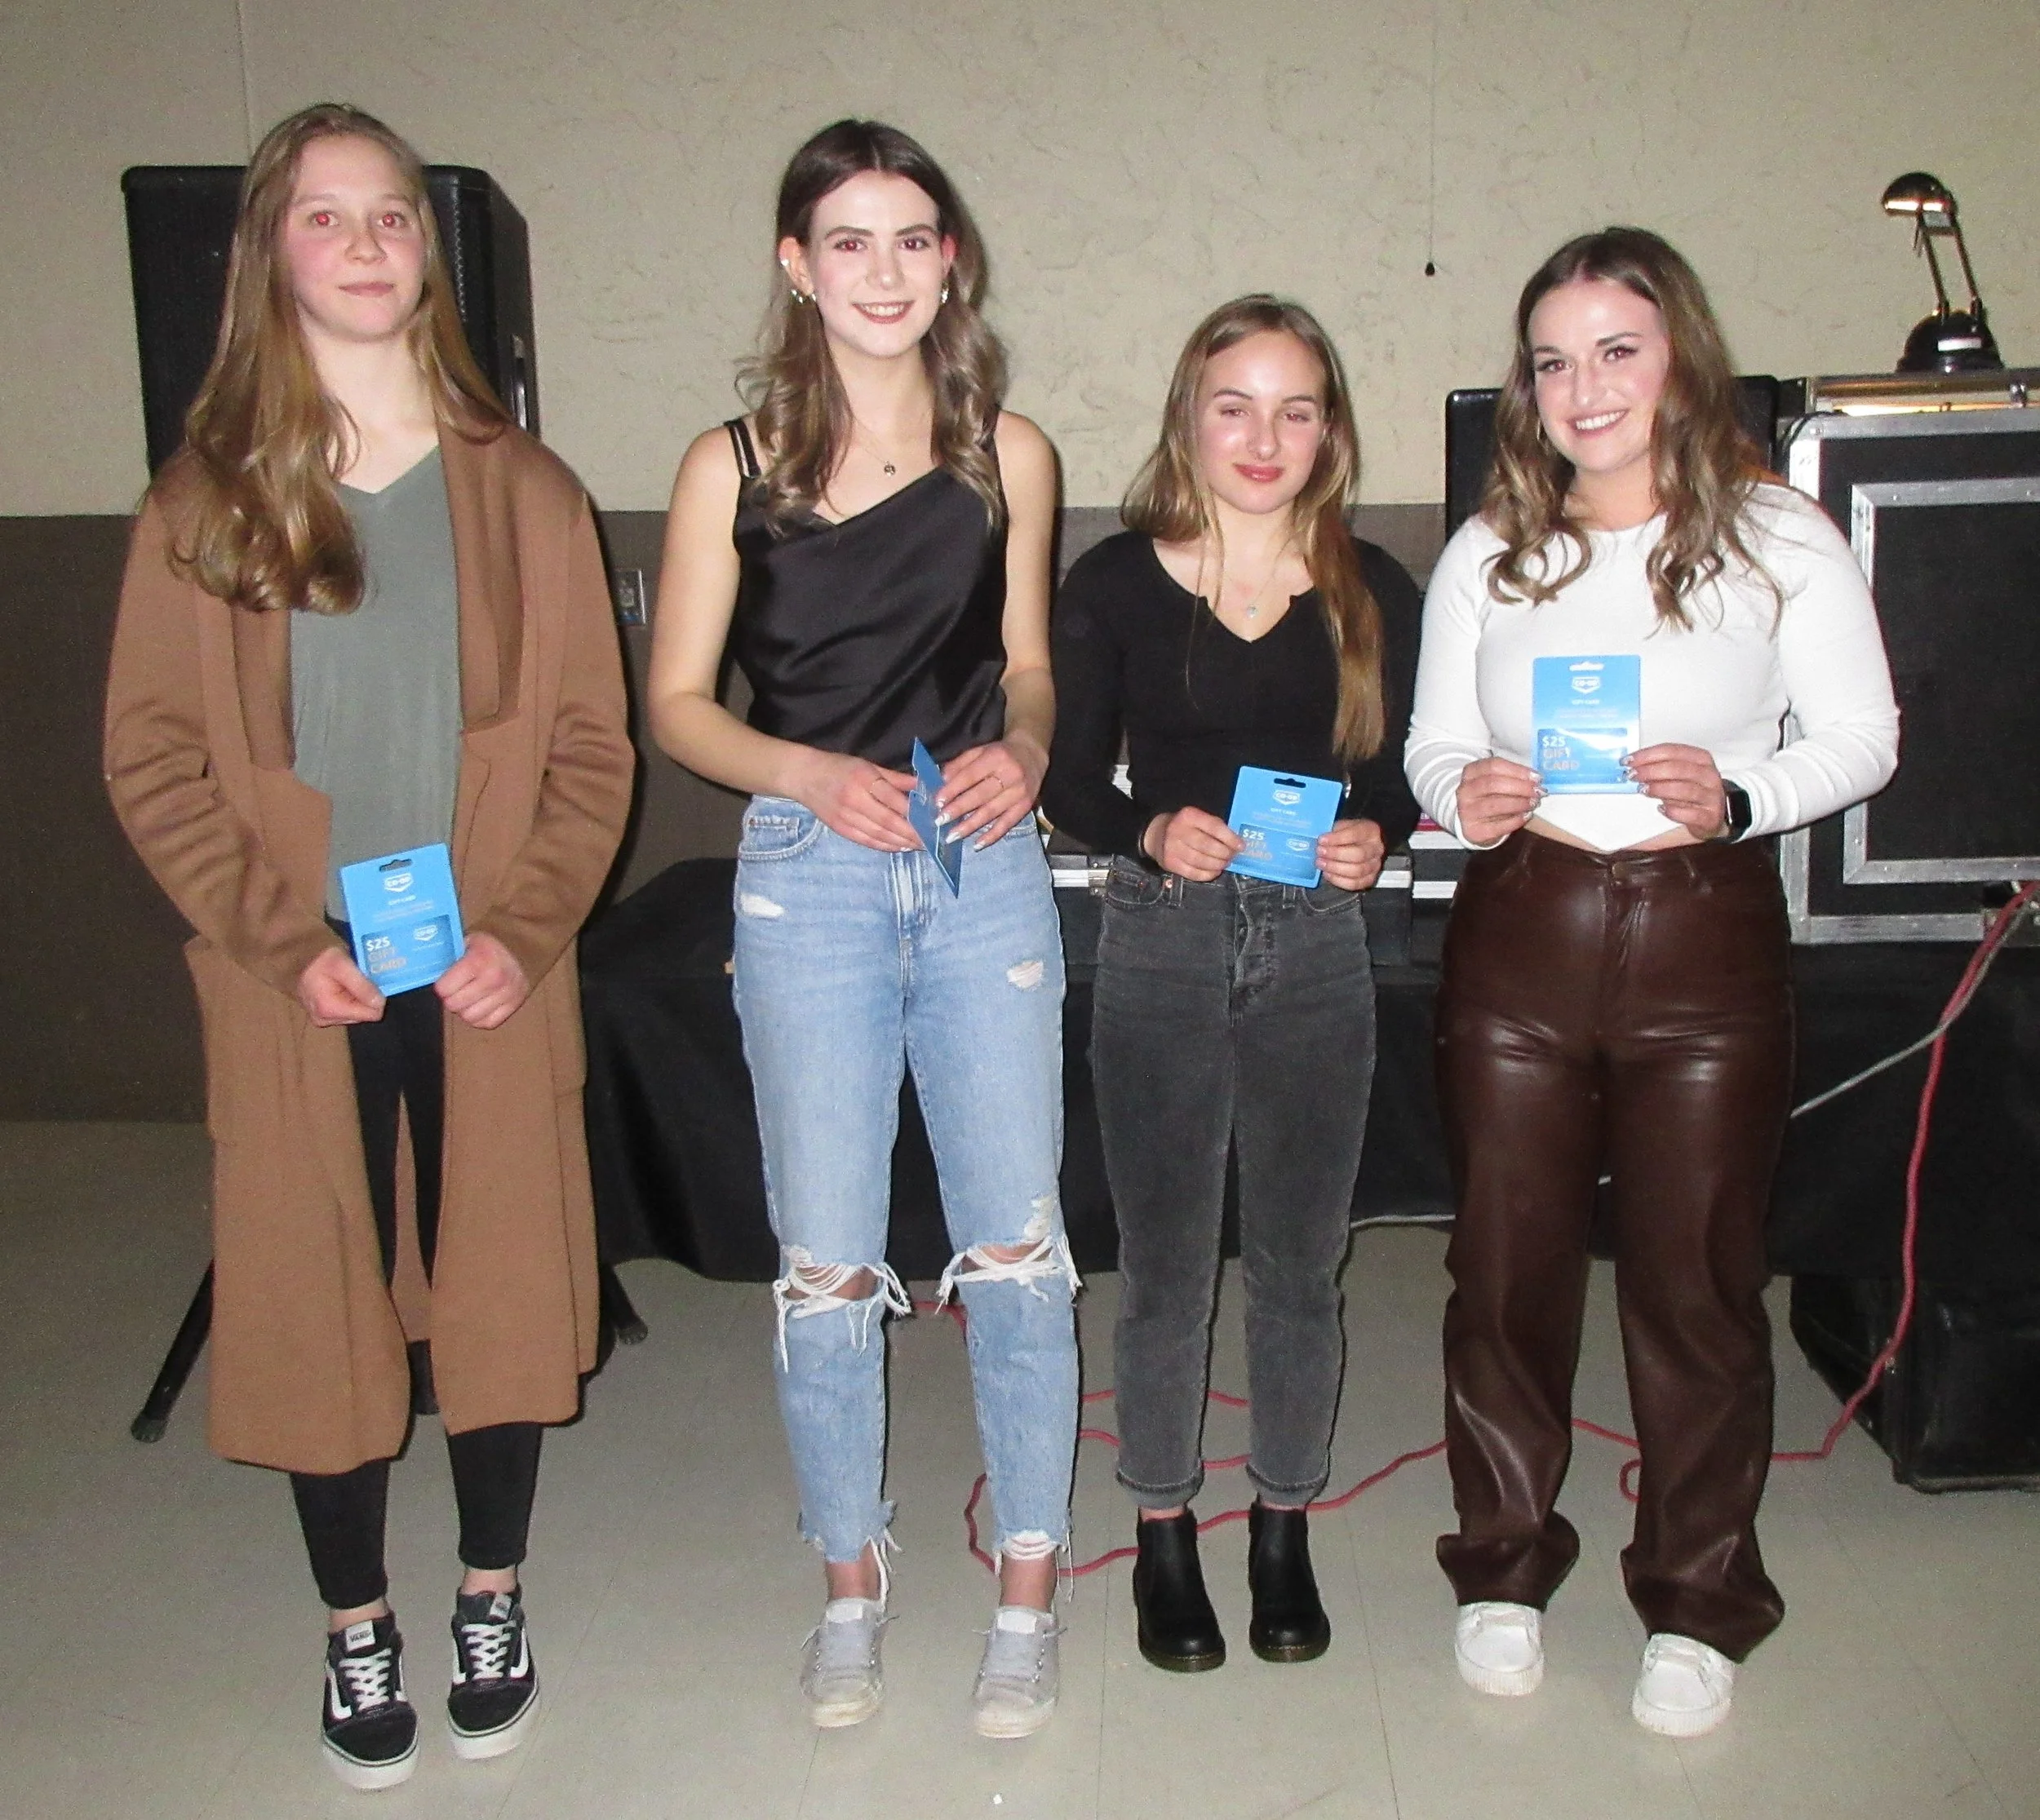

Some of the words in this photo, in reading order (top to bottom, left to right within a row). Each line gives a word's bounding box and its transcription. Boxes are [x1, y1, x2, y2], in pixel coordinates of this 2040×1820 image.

[1542, 736, 1566, 747] $25
[1243, 828, 1265, 840] $25
[366, 936, 391, 952] $25
